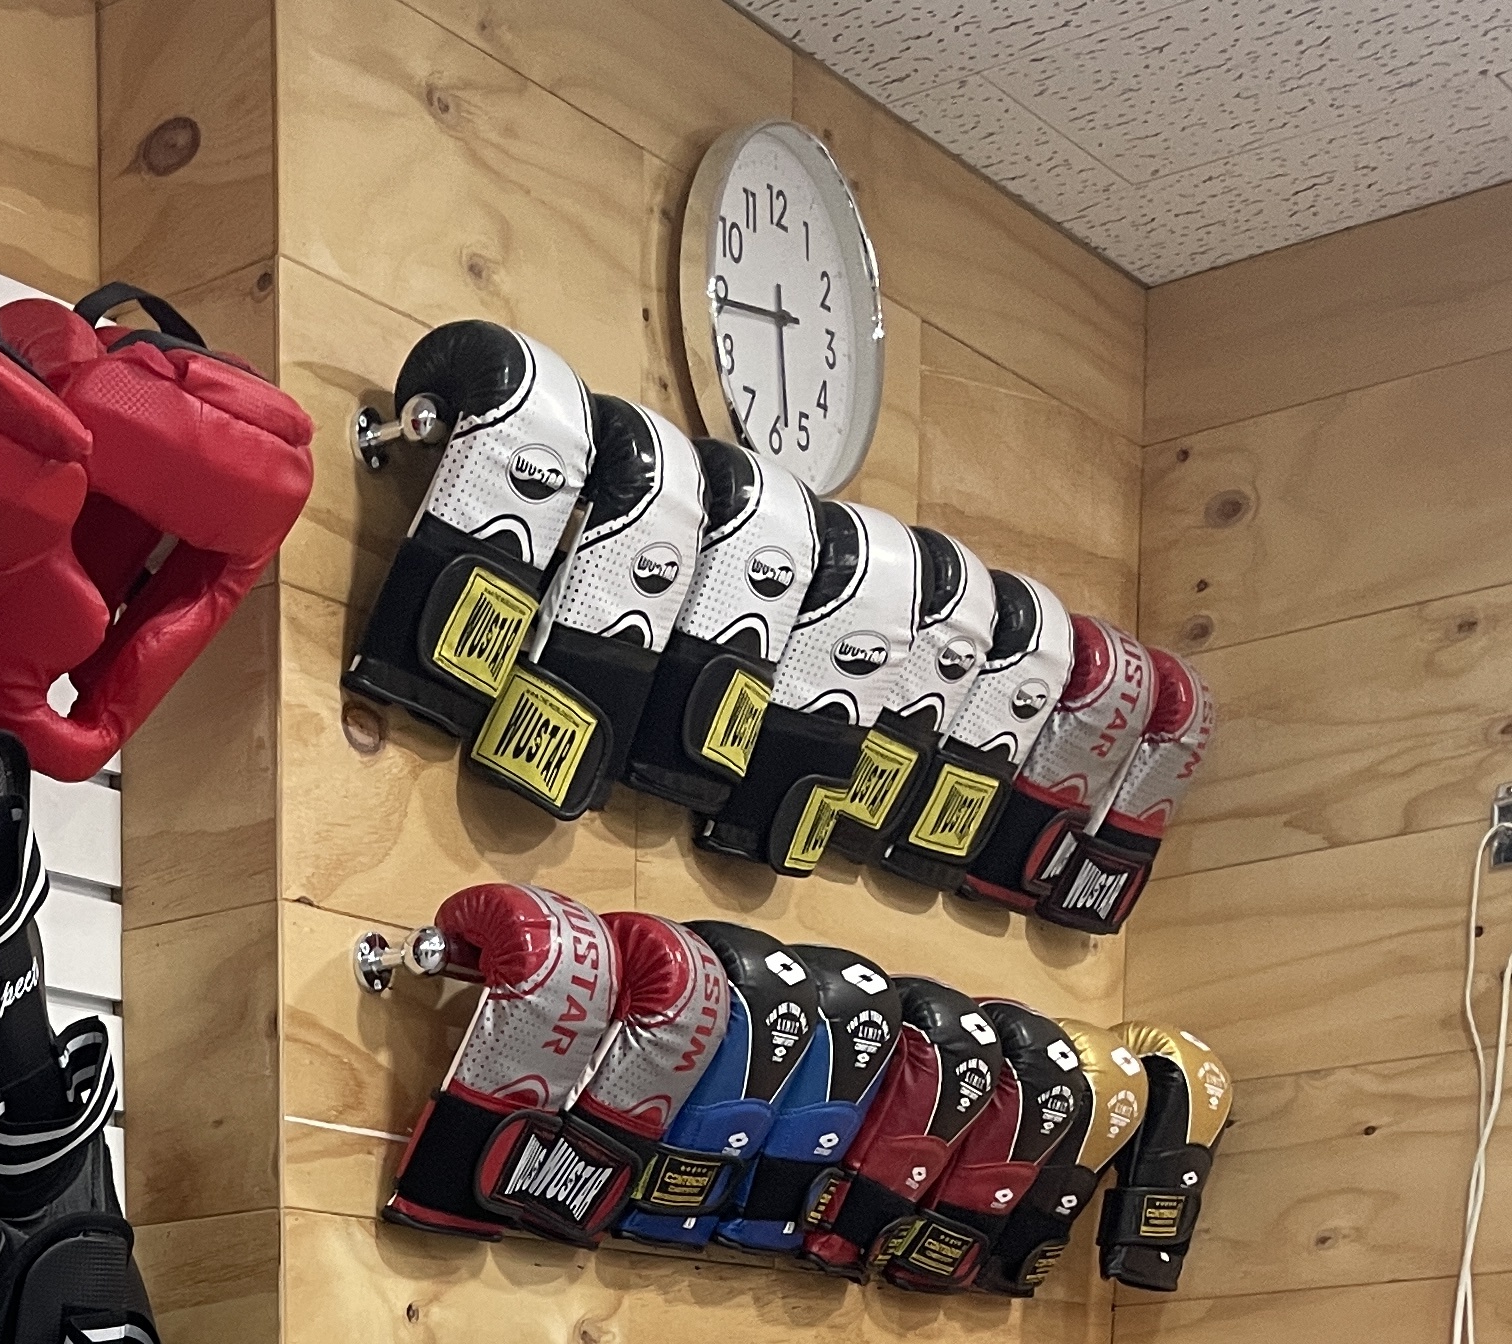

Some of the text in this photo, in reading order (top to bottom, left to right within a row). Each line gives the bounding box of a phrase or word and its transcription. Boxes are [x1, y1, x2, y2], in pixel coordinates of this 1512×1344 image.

[742, 187, 757, 233] 11
[766, 183, 789, 232] 12
[718, 215, 743, 263] 10
[802, 220, 810, 261] 1
[819, 270, 832, 313] 2
[723, 333, 735, 376] 8
[824, 328, 837, 371] 3
[742, 385, 757, 426] 7
[816, 379, 829, 419] 4
[769, 415, 783, 455] 6
[796, 411, 811, 452] 5
[454, 591, 523, 682] WUSTAR
[493, 691, 577, 793] WUSTAR
[529, 1137, 614, 1221] WUSTAR
